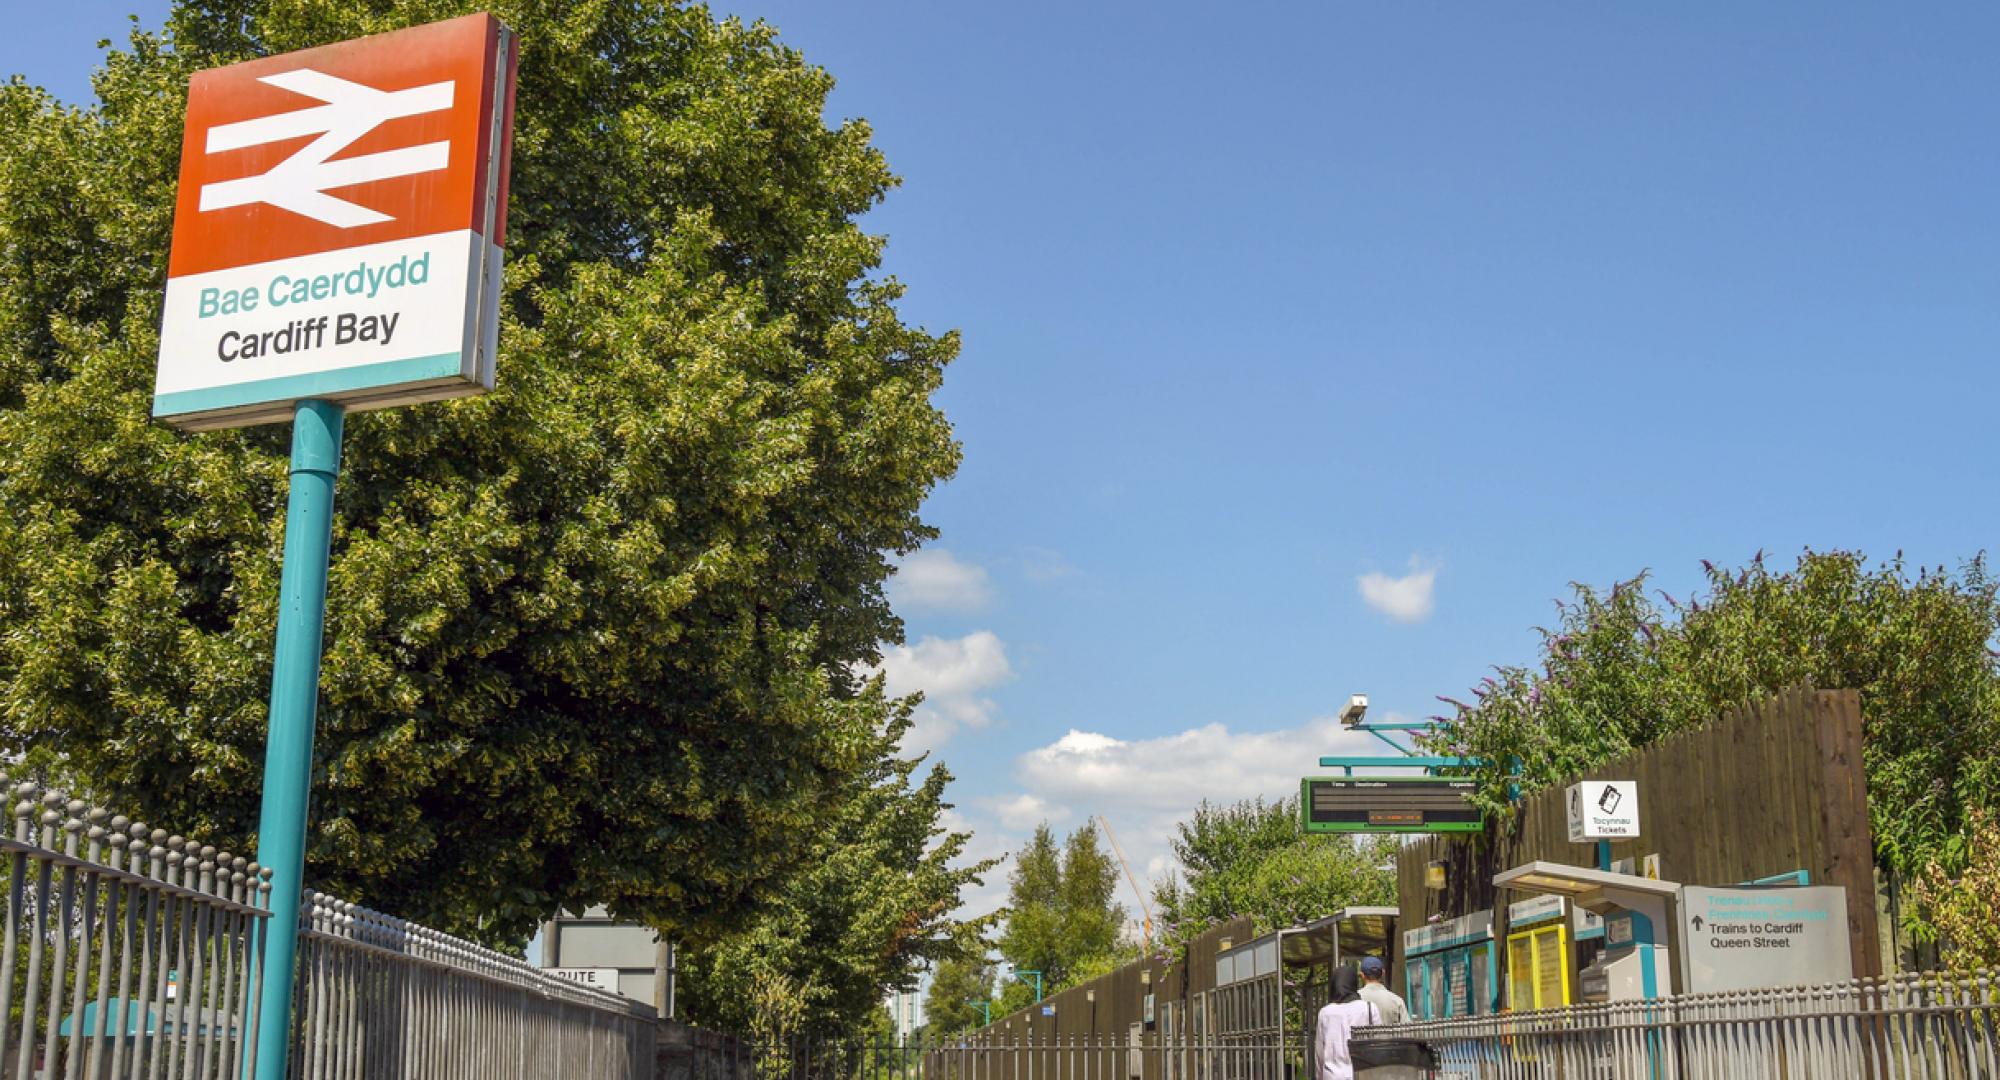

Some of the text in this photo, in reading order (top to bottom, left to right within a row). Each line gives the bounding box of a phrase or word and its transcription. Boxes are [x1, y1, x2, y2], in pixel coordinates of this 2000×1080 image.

[198, 251, 430, 319] Bae Caerdydd
[217, 312, 400, 362] Cardiff Bay
[1597, 826, 1627, 834] Tickets
[1709, 922, 1804, 934] Trains to Cardiff
[1710, 937, 1791, 949] Queen Street
